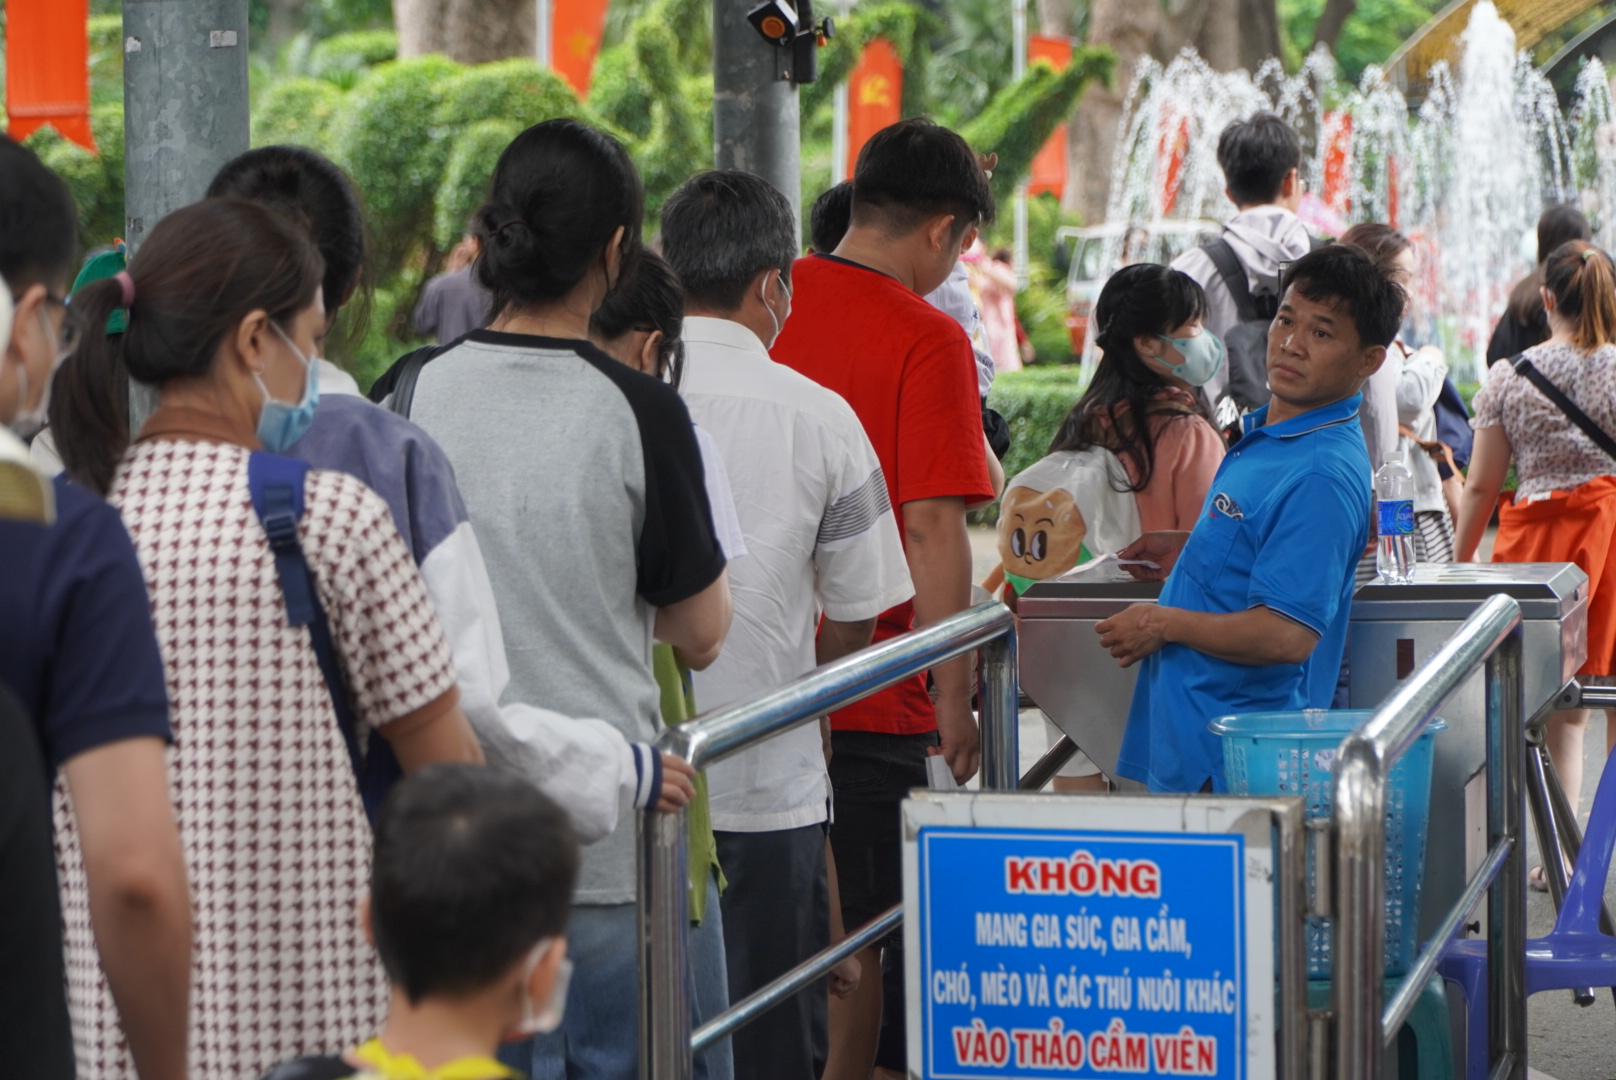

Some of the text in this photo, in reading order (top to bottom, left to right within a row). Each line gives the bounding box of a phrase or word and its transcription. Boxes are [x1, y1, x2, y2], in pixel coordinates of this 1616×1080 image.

[1006, 850, 1161, 898] KHÔNG
[975, 903, 1192, 959] MANG GIA SÚC, GIA CẦM,
[933, 962, 1236, 1015] CHÓ, MÈO VÀ CÁC THÚ NUÔI KHÁC
[953, 1017, 1218, 1076] VÀO THẢO CẦM VIÊN
